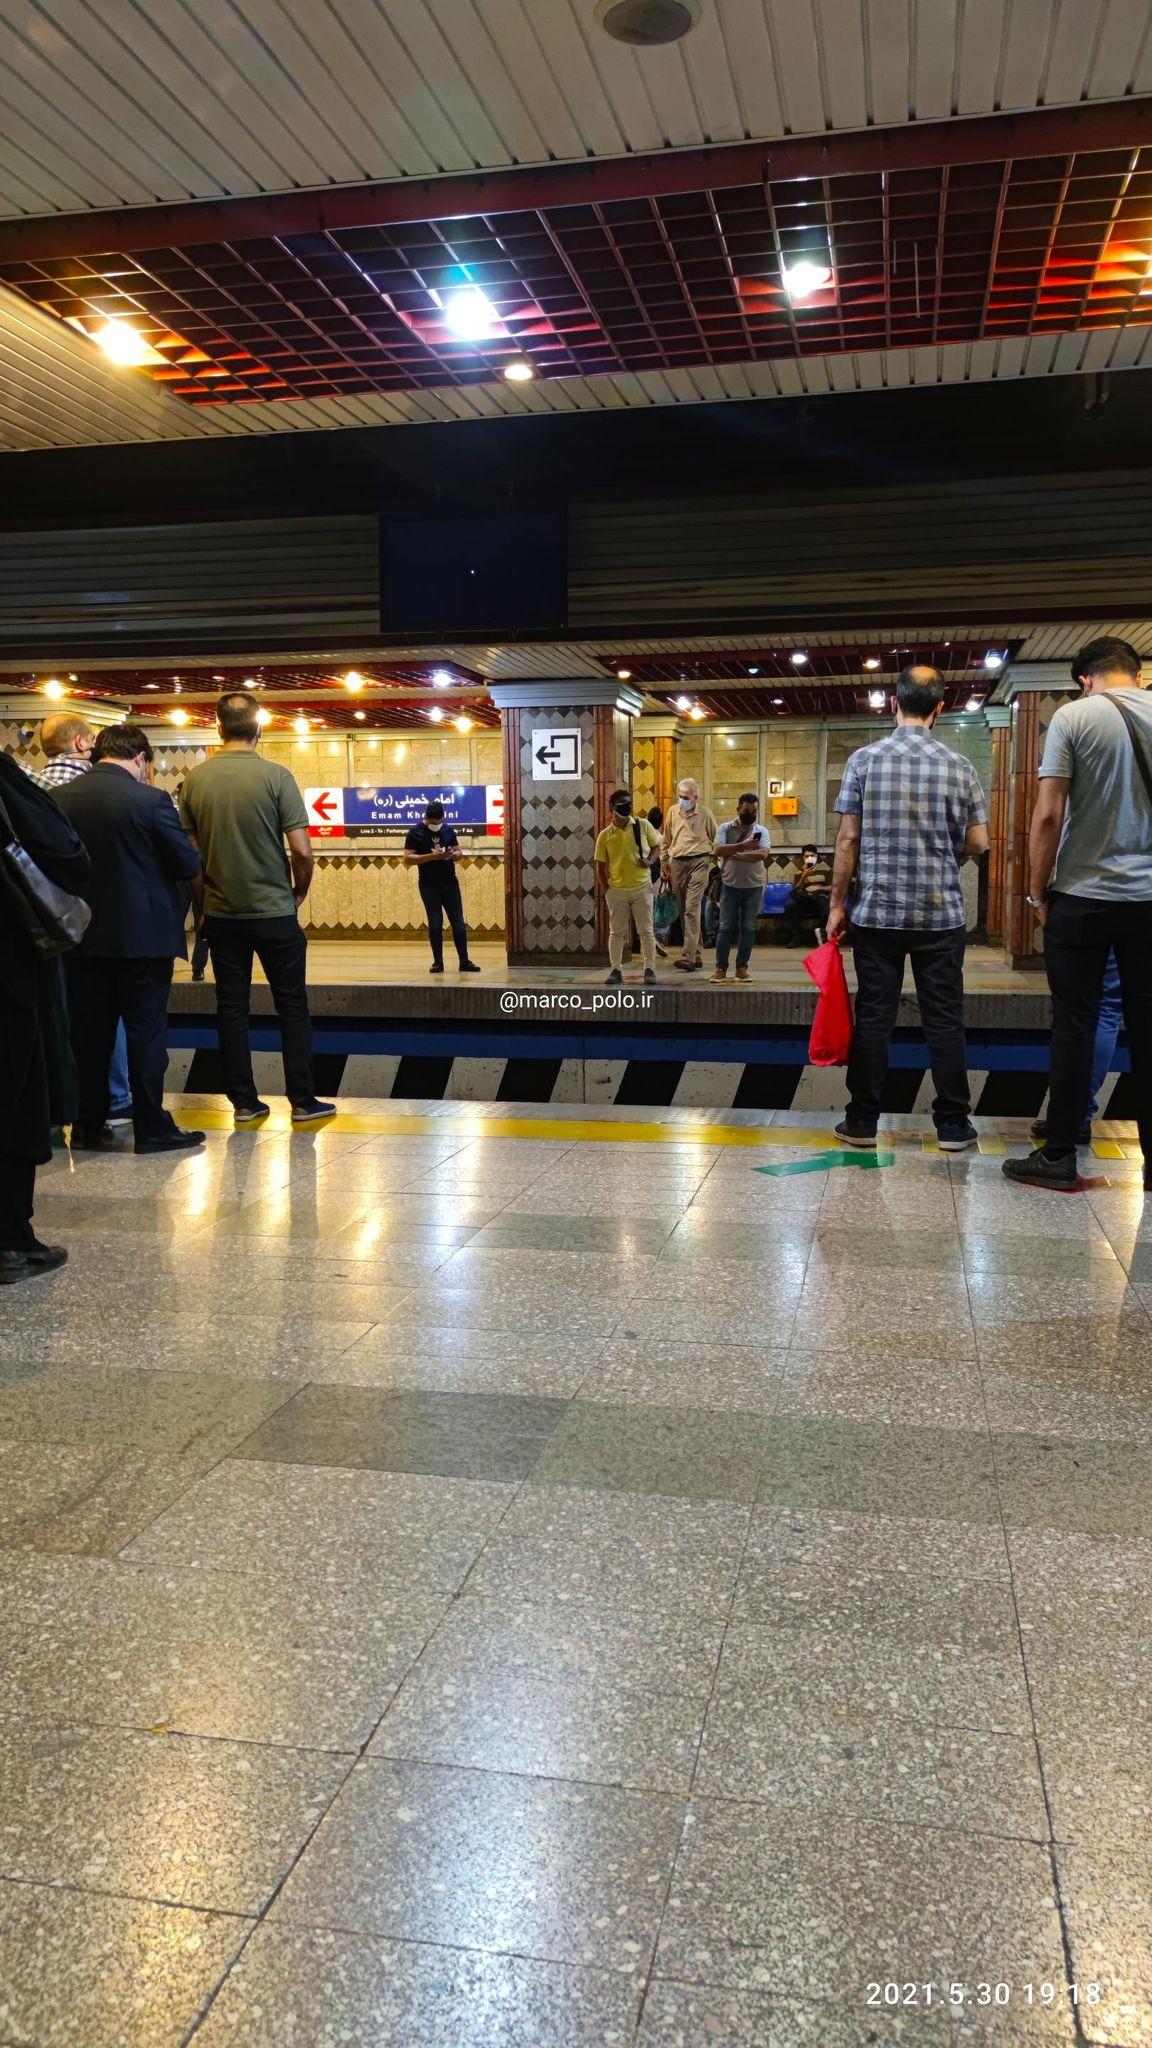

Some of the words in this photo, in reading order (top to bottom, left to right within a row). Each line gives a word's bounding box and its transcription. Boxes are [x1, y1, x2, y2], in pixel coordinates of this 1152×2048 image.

[373, 794, 393, 807] (ره)
[395, 793, 429, 808] خمینی
[371, 811, 402, 819] Emam
[407, 811, 458, 819] Khoini
